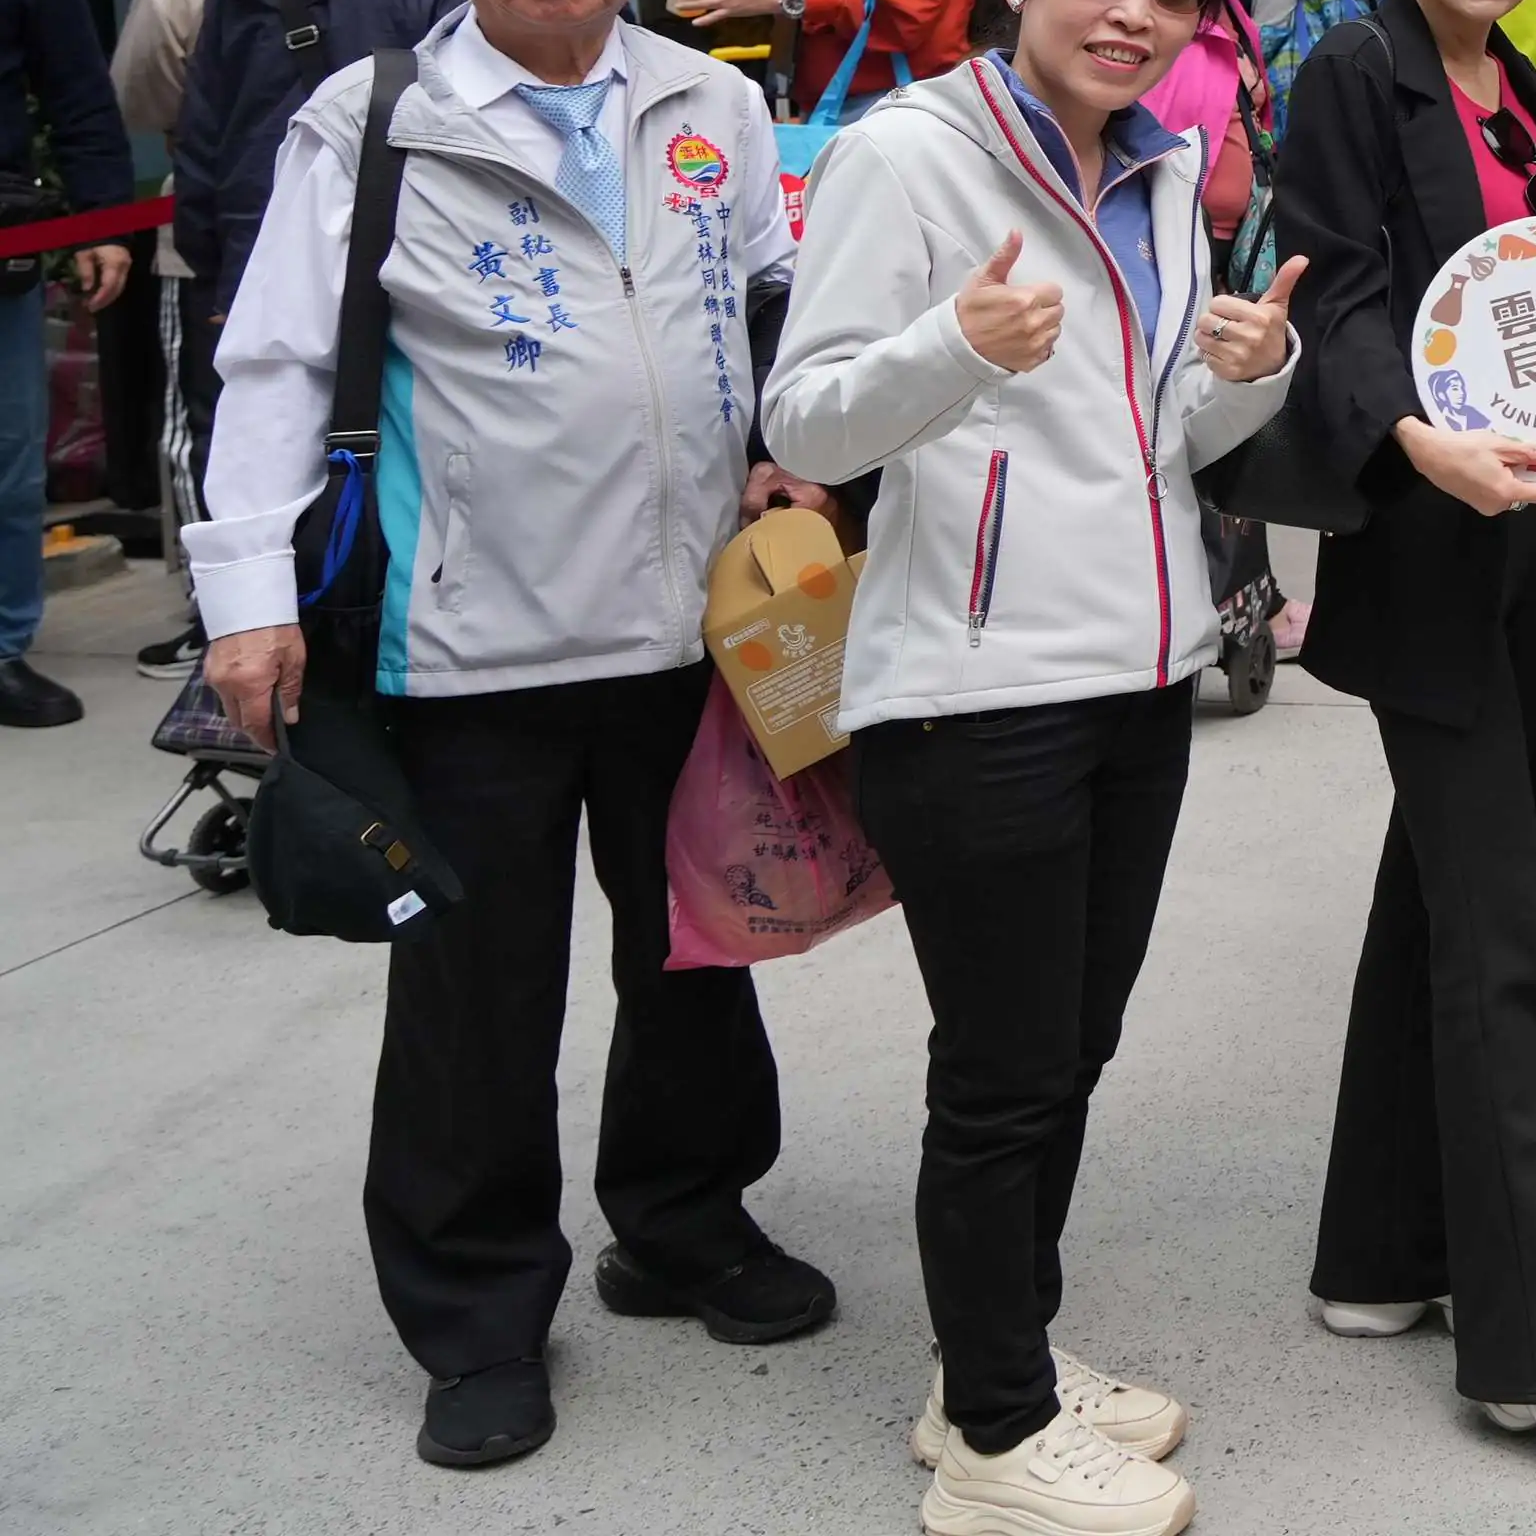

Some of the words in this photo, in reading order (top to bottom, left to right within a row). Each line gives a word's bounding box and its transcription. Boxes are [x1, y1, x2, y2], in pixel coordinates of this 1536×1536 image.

[678, 144, 709, 161] 雲林
[468, 241, 542, 374] 黃文卿
[507, 196, 578, 334] 副秘書長
